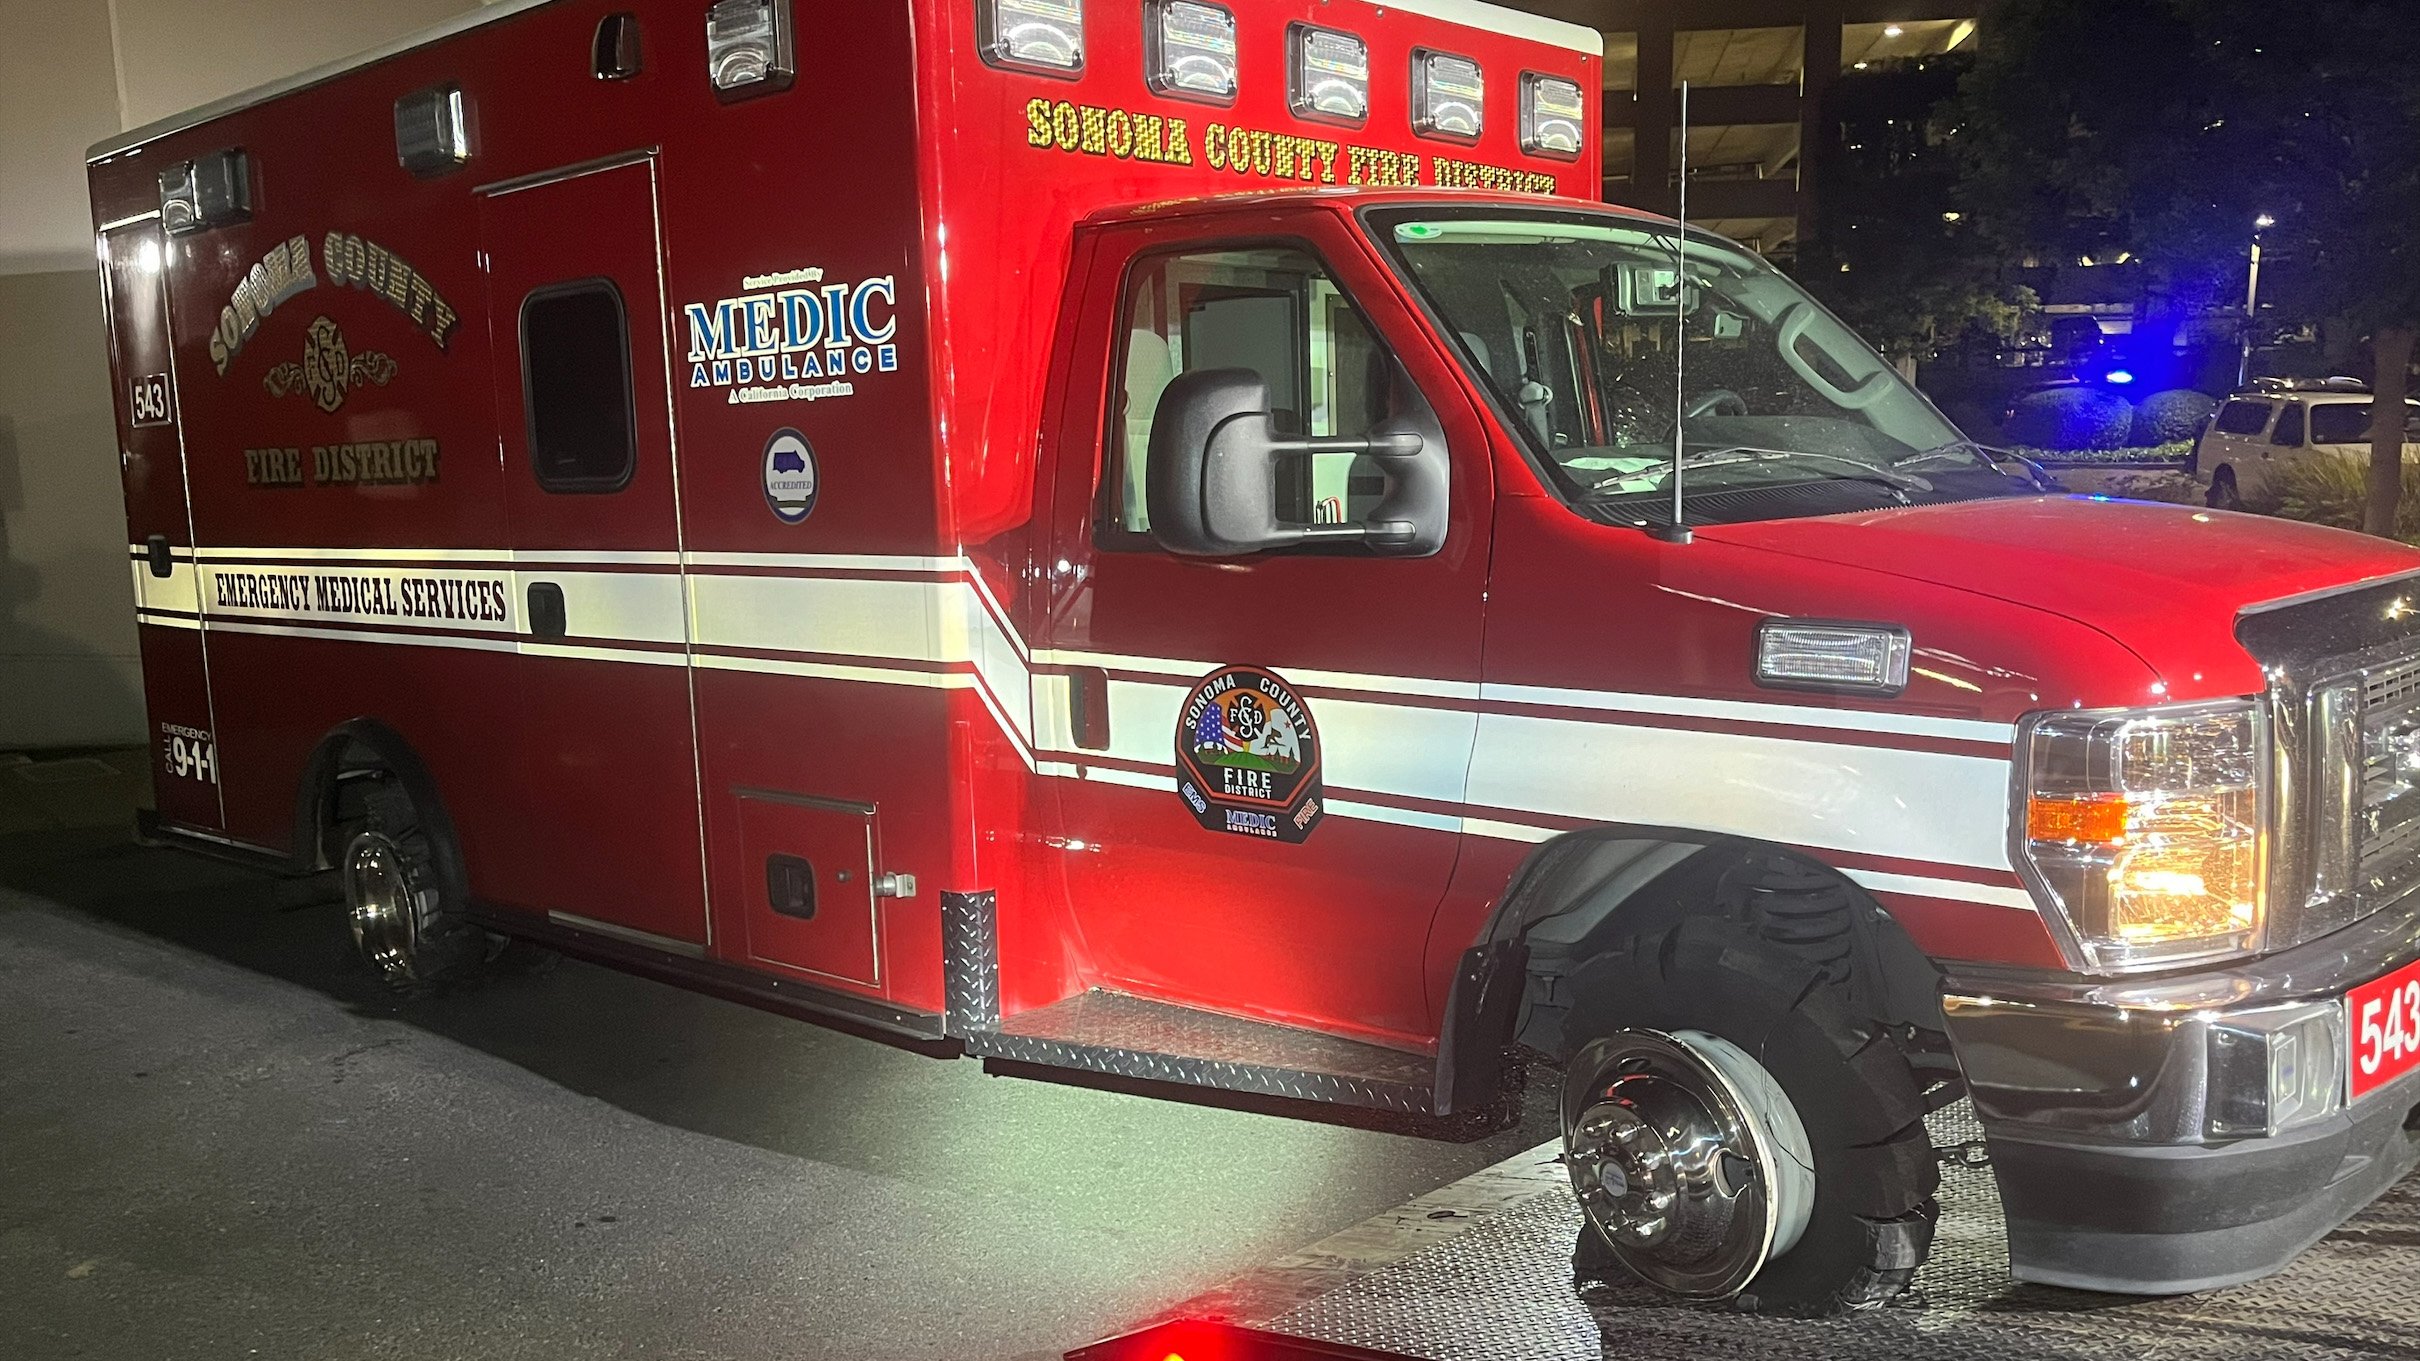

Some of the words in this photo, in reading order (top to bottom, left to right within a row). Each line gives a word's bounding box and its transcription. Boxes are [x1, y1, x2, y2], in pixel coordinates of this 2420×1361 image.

[1026, 97, 1193, 167] SONOMA
[1204, 122, 1339, 183] COUNTY
[1347, 144, 1420, 187] FIRE
[210, 234, 317, 377] SONOMA
[323, 230, 459, 350] COUNTY
[685, 275, 896, 361] MEDIC
[691, 344, 897, 387] AMBULANCE
[135, 383, 164, 419] 543
[728, 389, 740, 404] A
[740, 385, 789, 402] California
[789, 381, 853, 401] Corporation
[244, 446, 302, 484] FIRE
[313, 438, 439, 483] DISTRICT
[770, 480, 812, 490] ACCREDITED
[215, 573, 310, 611] EMERGENCY
[314, 575, 398, 616] MEDICAL
[400, 577, 506, 622] SERVICES
[1186, 674, 1236, 730] SONOMA
[1260, 677, 1311, 740] COUNTY
[162, 722, 212, 741] EMERGENCY
[164, 735, 174, 774] CALL
[1224, 768, 1272, 789] FIRE
[1225, 783, 1272, 799] DISTRICT
[1225, 809, 1276, 831] MEDIC
[1293, 798, 1319, 830] FIRE
[2360, 980, 2420, 1075] 543
